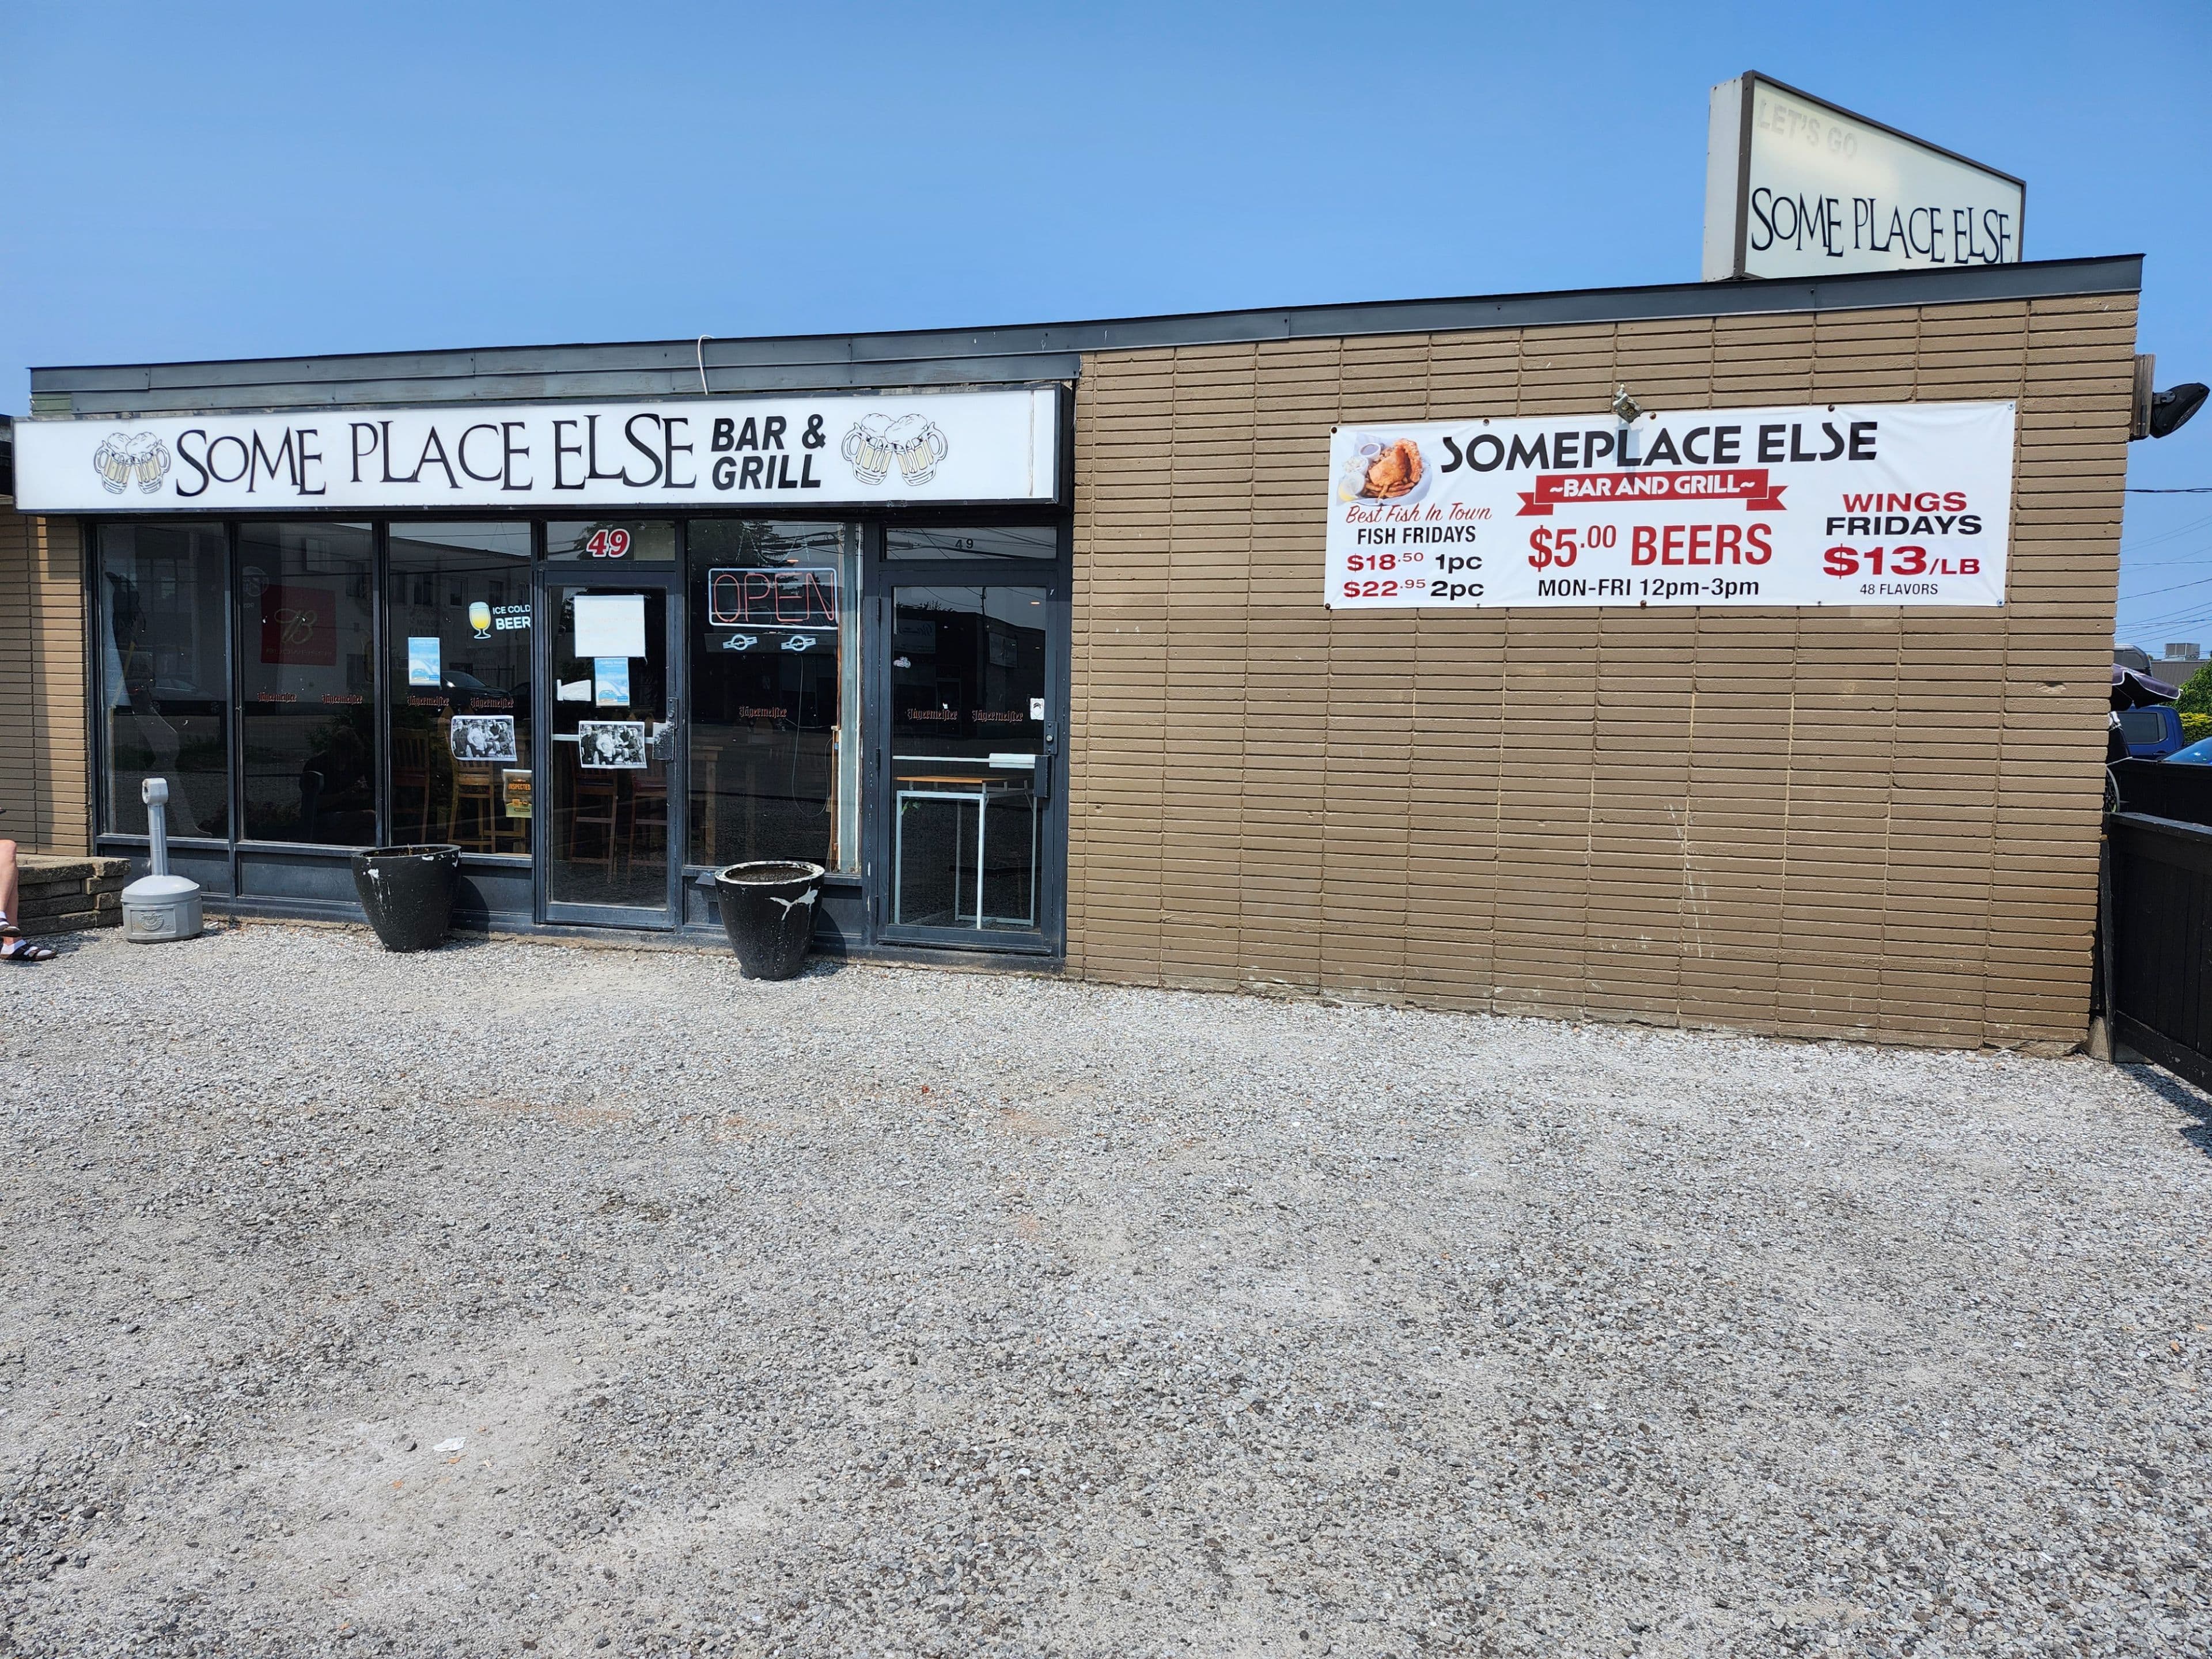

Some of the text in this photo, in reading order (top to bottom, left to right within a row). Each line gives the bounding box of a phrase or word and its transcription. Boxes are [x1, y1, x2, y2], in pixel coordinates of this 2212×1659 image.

[1759, 99, 1857, 160] LET'S GO
[1752, 188, 2013, 264] SOME PLACE ELSE
[711, 414, 825, 452] BAR &
[176, 414, 696, 497] SOME PLACE ELSE
[1441, 422, 1877, 473] SOMEPLACE ELSE
[713, 454, 821, 490] GRILL
[1615, 476, 1669, 496] AND
[1843, 492, 1966, 512] WINGS
[1346, 502, 1492, 524] Best Fish In Town
[1358, 526, 1475, 544] FISH FRIDAYS
[1827, 515, 1982, 535] FRIDAYS
[586, 529, 630, 557] 49
[955, 538, 974, 550] 49
[1631, 523, 1771, 565] BEERS
[1435, 554, 1482, 574] 1pc
[713, 572, 835, 622] OPEN
[1431, 581, 1483, 600] 2pc
[1539, 578, 1758, 599] MON-FRI 12pm-3pm
[1860, 584, 1938, 594] 48 FLAVORS
[508, 605, 531, 615] COLD
[496, 616, 531, 630] BEER
[508, 783, 531, 791] INSPECTED
